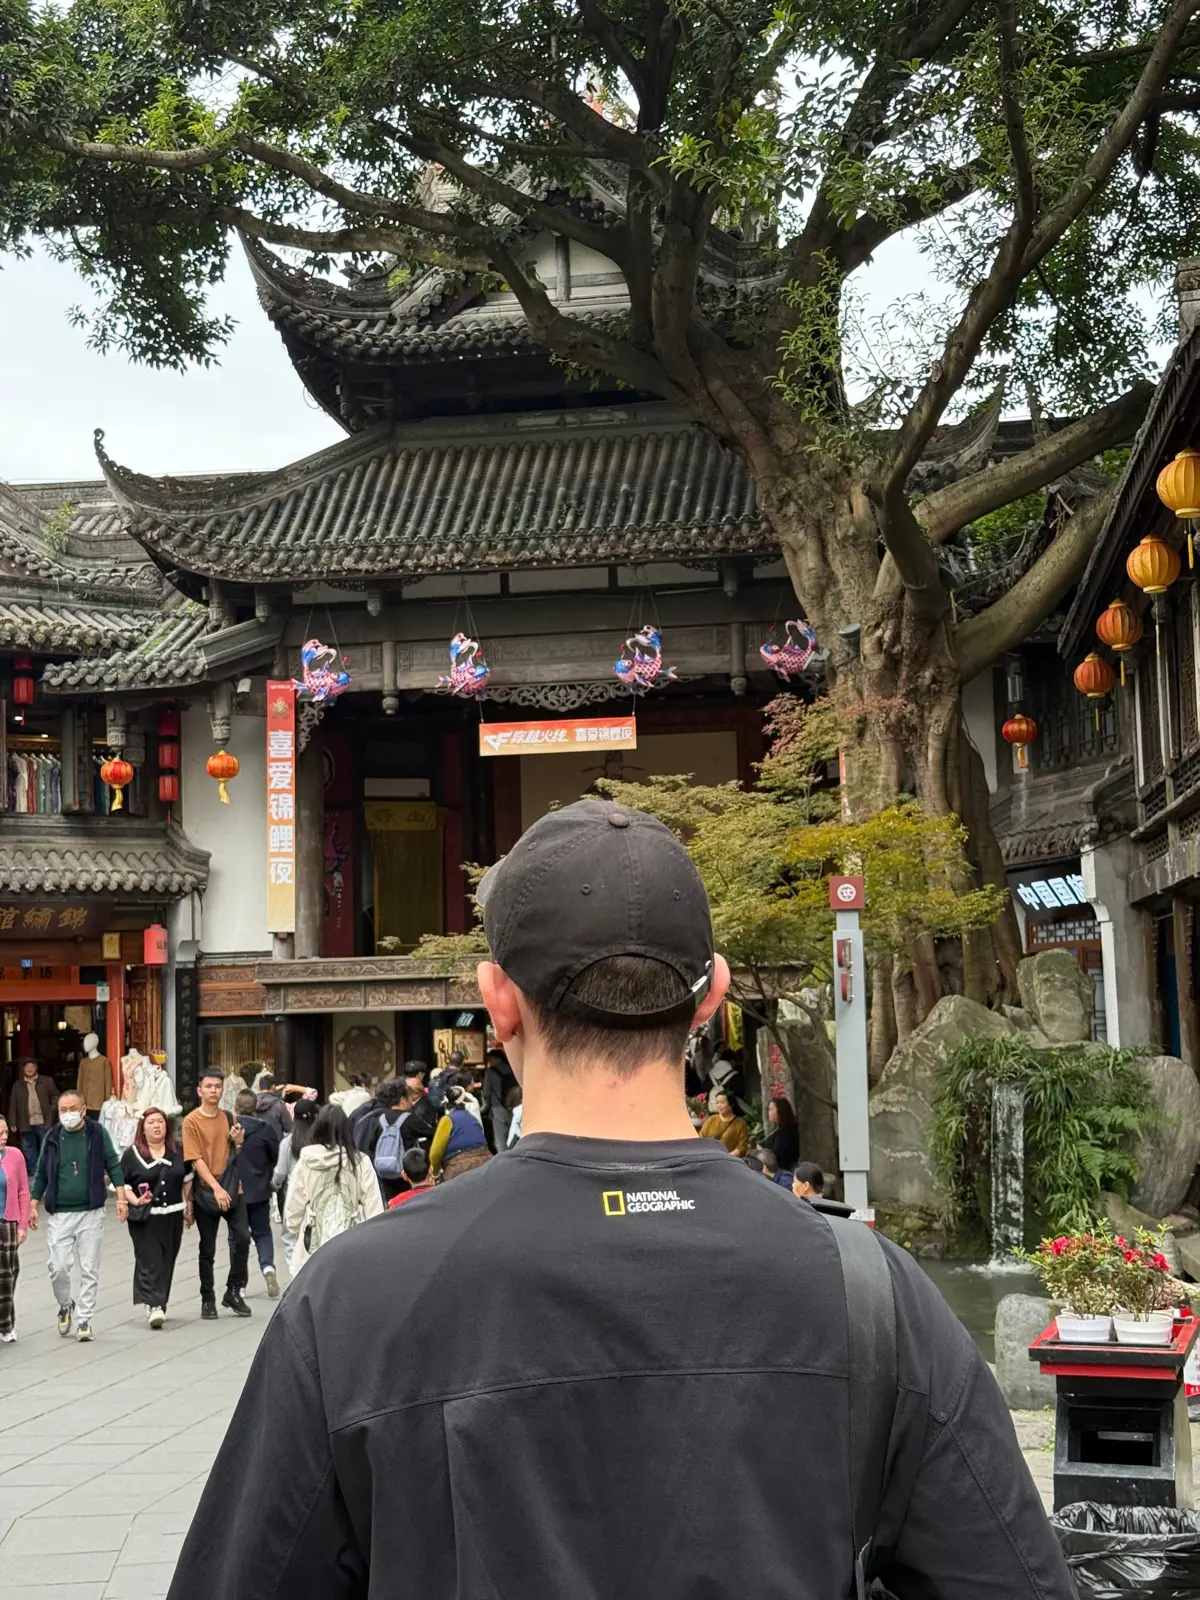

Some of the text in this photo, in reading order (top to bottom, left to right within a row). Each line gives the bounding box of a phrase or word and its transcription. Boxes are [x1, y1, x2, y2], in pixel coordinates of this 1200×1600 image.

[268, 730, 294, 885] 喜爱锦鲤夜
[626, 1191, 680, 1202] NATIONAL
[627, 1200, 695, 1212] GEOGRAPHIC
